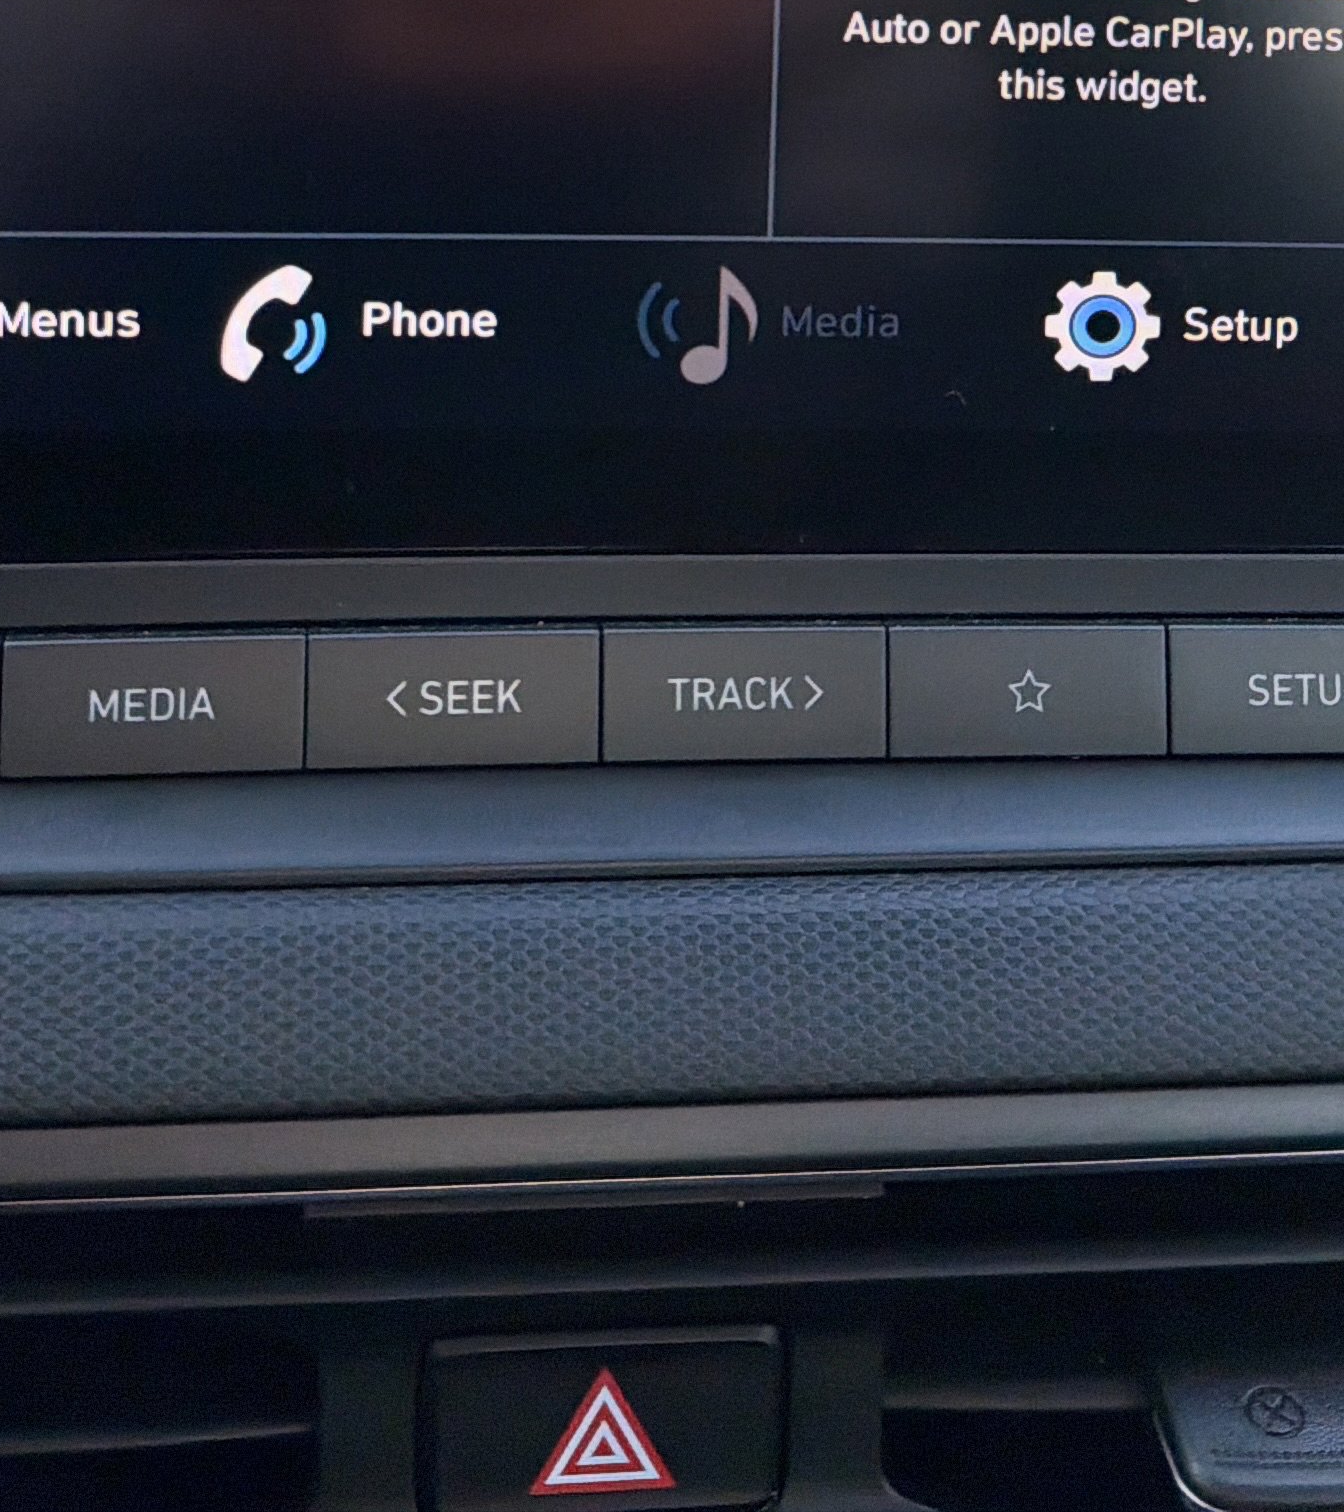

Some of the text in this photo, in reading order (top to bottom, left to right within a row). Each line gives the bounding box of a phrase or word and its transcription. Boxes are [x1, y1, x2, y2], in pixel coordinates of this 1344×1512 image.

[843, 10, 930, 44] Auto
[939, 19, 981, 45] or
[989, 14, 1096, 54] Apple
[1106, 15, 1254, 57] CarPlay,
[998, 67, 1207, 110] this widget.
[362, 300, 498, 338] Phone
[782, 304, 899, 338] Media
[1183, 306, 1299, 350] Setup
[89, 687, 215, 722] MEDIA
